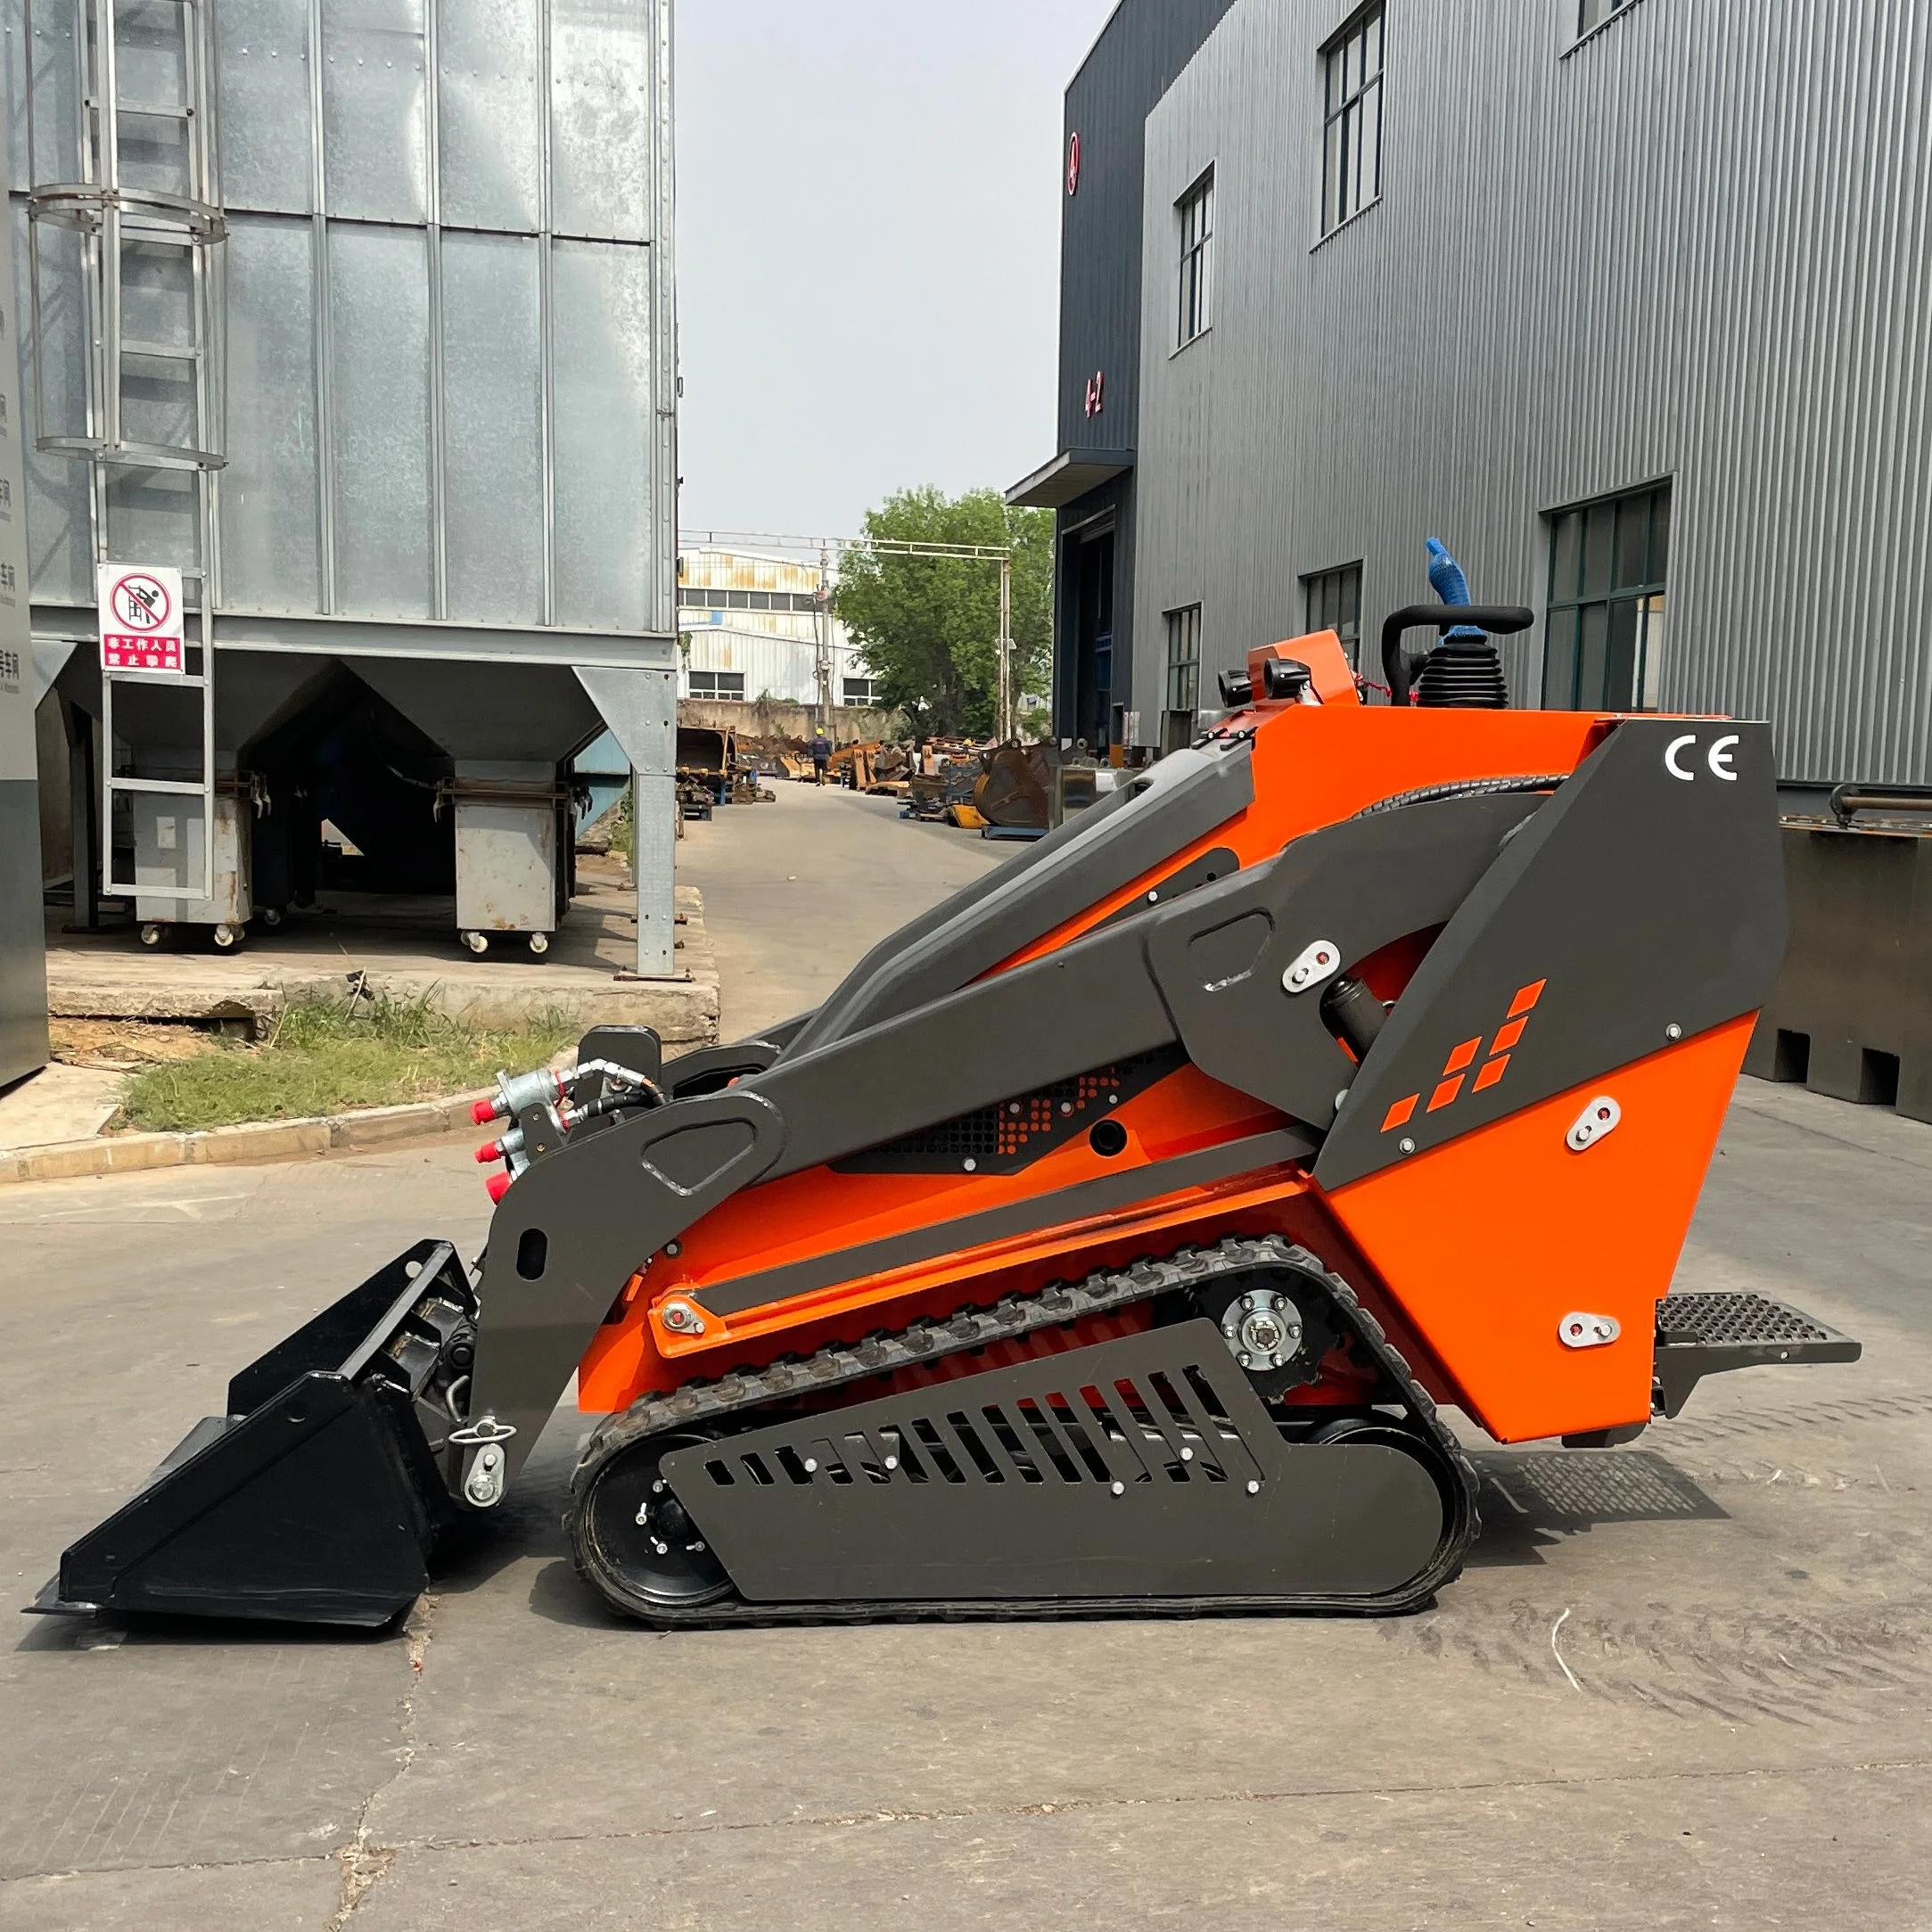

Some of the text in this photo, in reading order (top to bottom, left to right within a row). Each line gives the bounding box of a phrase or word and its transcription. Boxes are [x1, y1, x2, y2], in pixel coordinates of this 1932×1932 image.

[108, 637, 177, 653] 非工作人员
[109, 653, 177, 668] 禁止攀爬
[1665, 735, 1739, 781] CE
